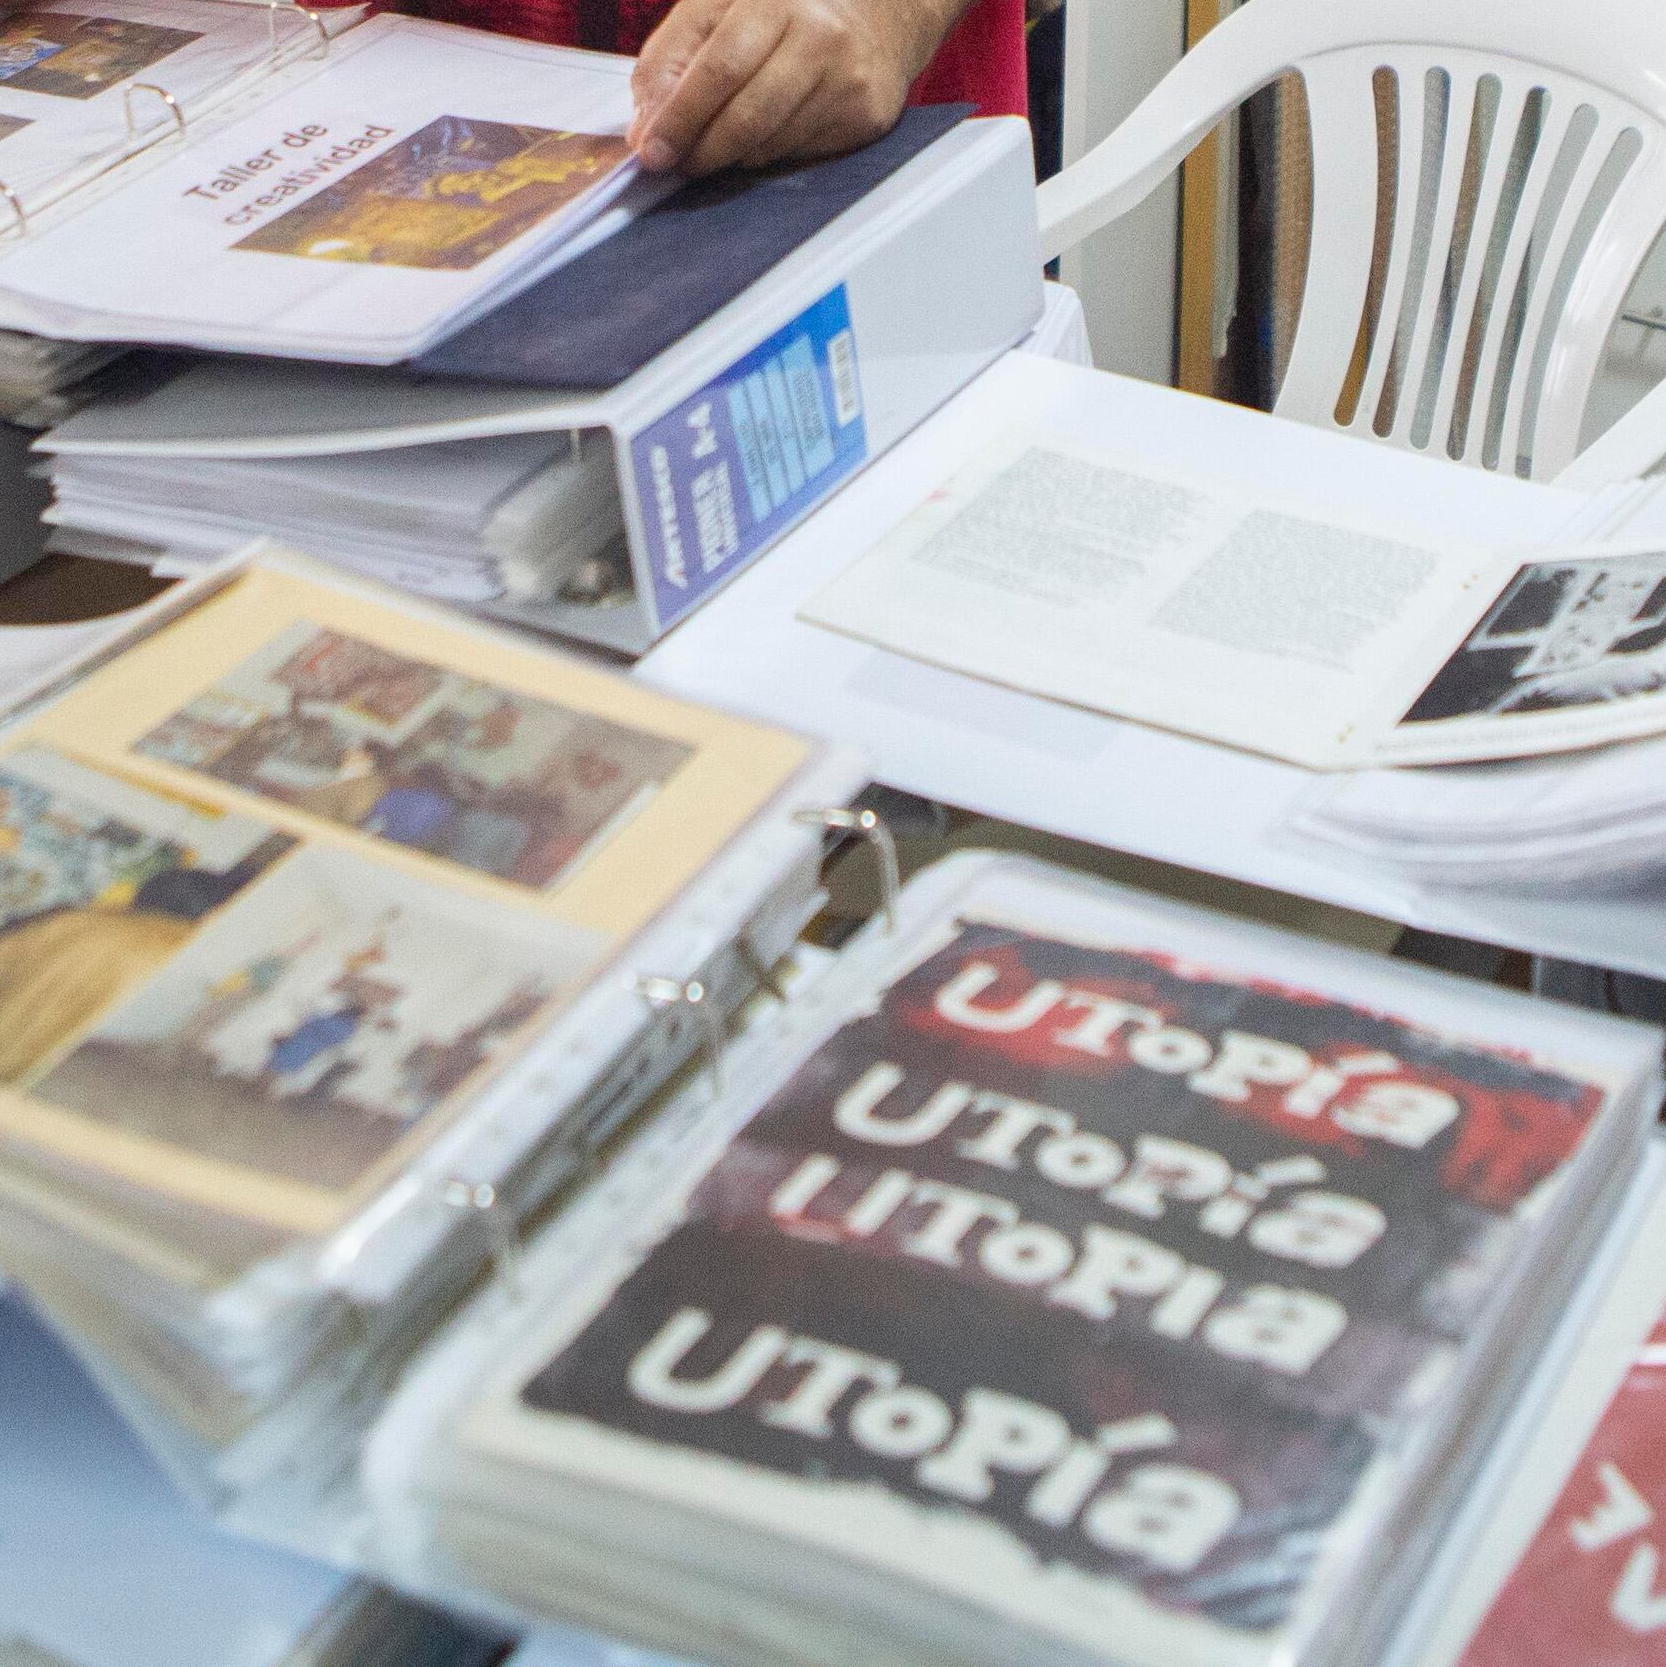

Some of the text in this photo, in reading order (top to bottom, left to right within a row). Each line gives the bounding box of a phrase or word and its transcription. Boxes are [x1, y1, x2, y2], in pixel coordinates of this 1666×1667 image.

[182, 119, 332, 204] Taller de
[223, 122, 397, 228] creatividad
